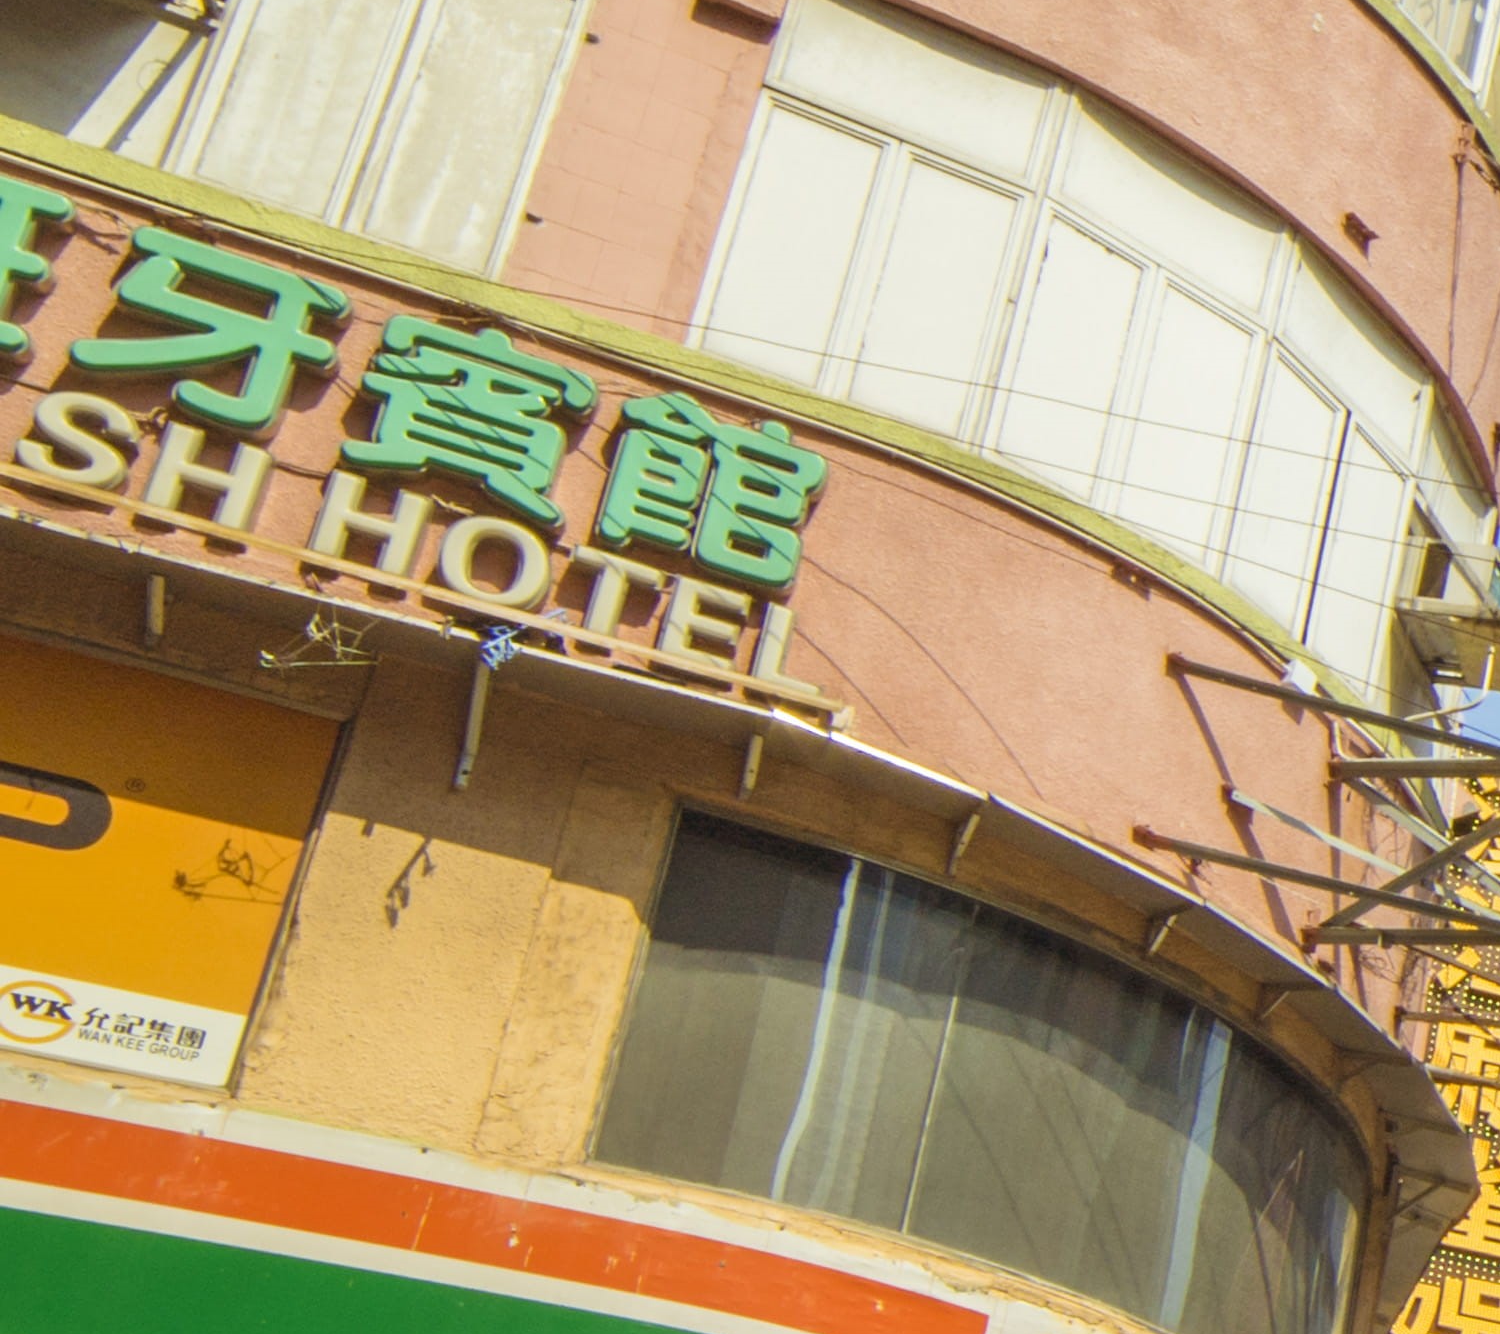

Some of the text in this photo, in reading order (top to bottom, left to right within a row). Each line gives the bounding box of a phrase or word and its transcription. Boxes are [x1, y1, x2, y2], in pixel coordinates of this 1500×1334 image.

[16, 391, 822, 699] SH HOTEL
[10, 992, 73, 1021] WK
[78, 1027, 201, 1062] WAN KEE GROUP
[80, 1007, 207, 1051] 允記集團
